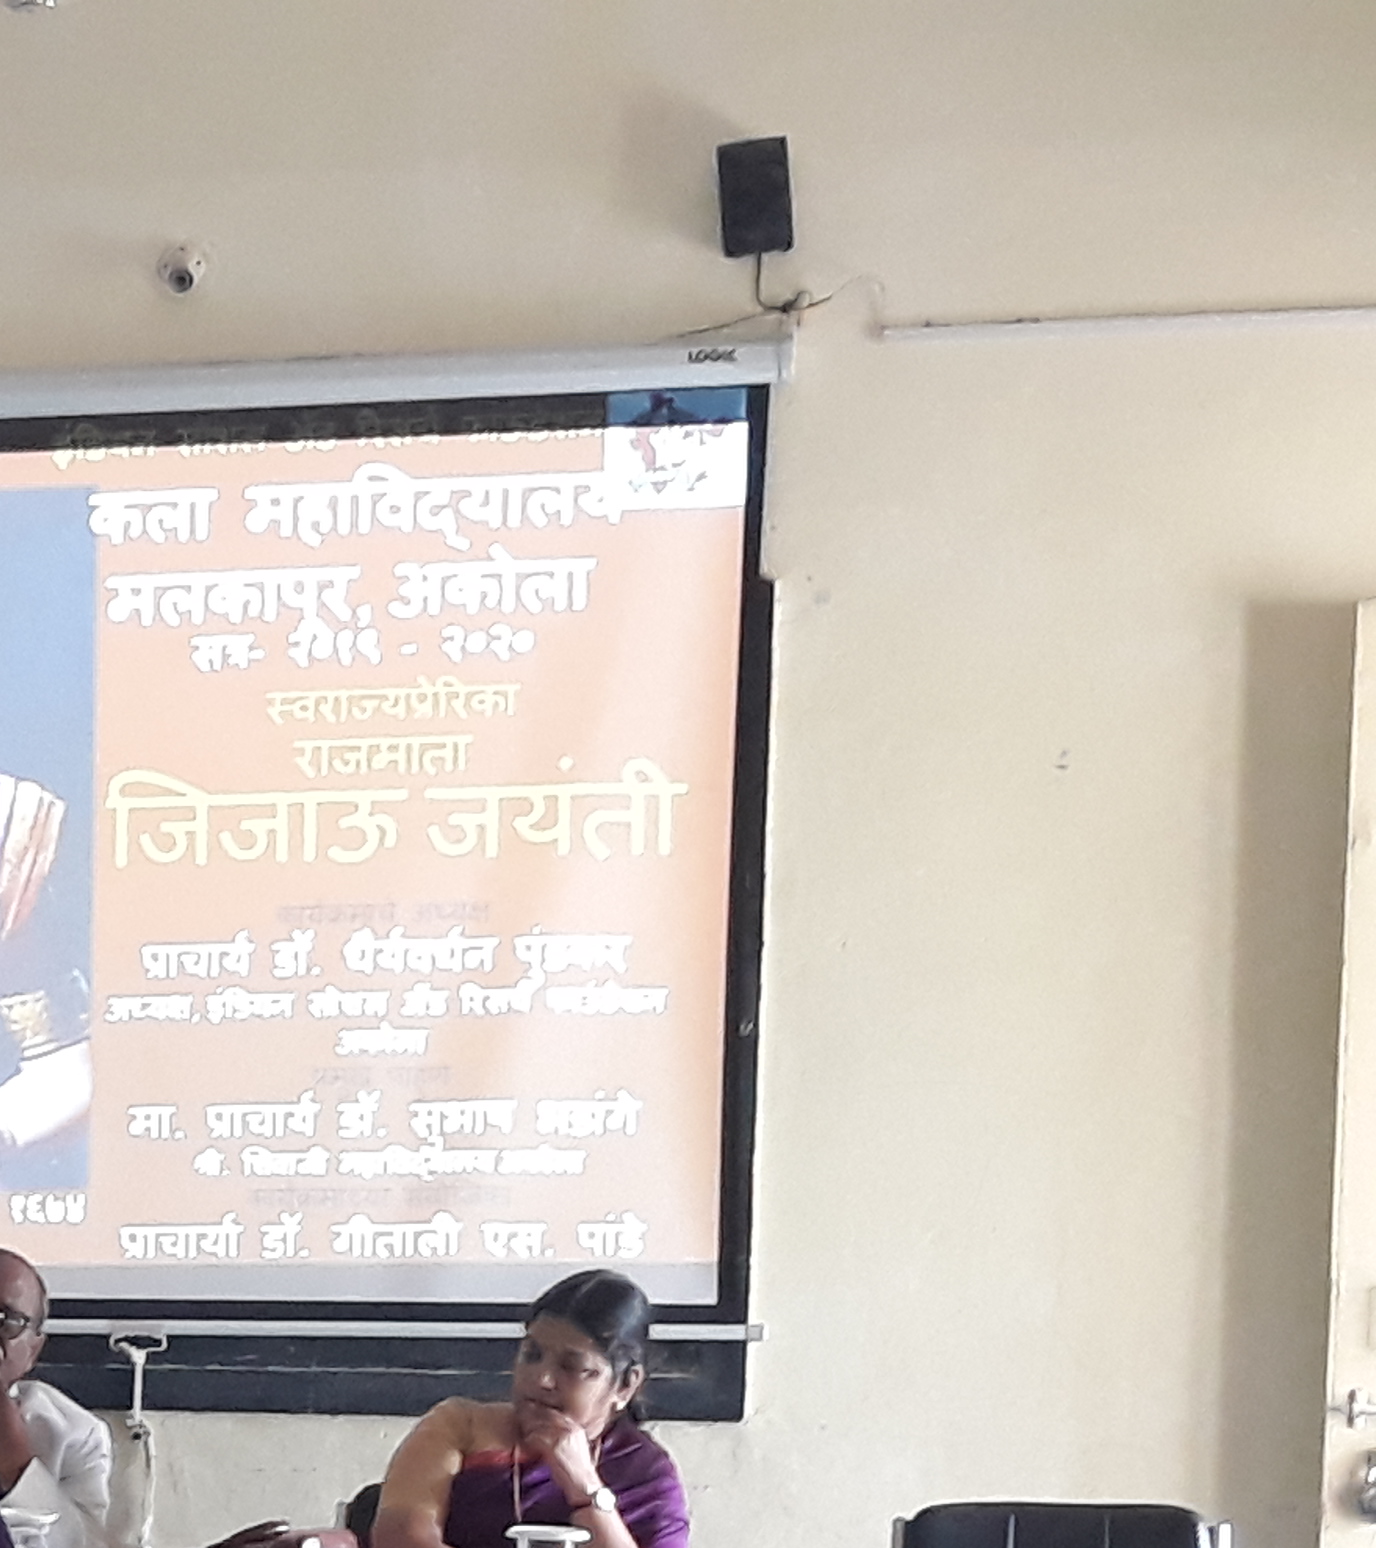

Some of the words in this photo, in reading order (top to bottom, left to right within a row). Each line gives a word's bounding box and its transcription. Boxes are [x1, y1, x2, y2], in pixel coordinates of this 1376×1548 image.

[87, 486, 220, 546] कला
[387, 542, 598, 621] अकोला
[440, 622, 536, 662] २०२०
[265, 674, 522, 724] स्वराज्यप्रेरिका
[293, 733, 474, 779] राजमाता
[105, 768, 408, 869] जिजाऊ
[424, 755, 690, 861] जयंती
[140, 929, 256, 979] प्राचार्य
[127, 1104, 187, 1140] मा.
[205, 1089, 322, 1139] प्राचार्य
[259, 1211, 310, 1259] डॉ.
[479, 1218, 555, 1259] एस.
[576, 1210, 649, 1259] पांडे
